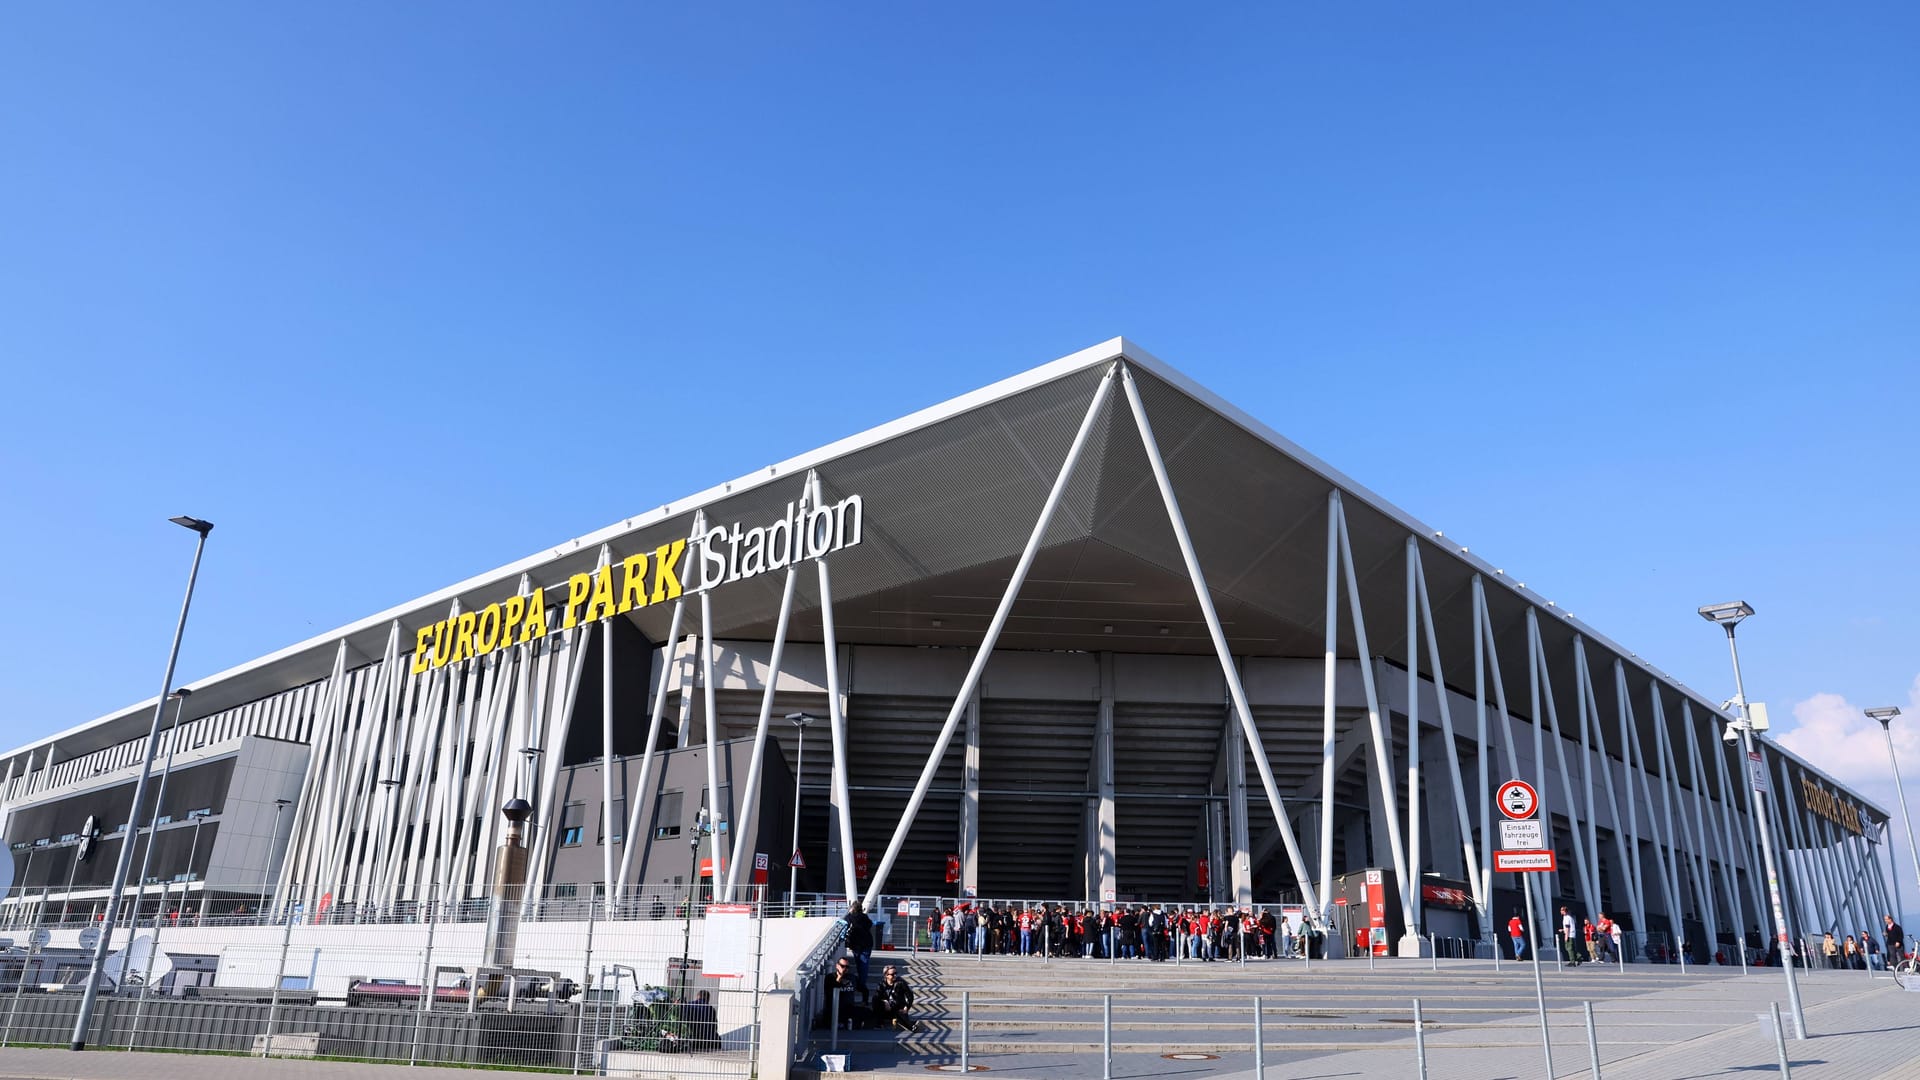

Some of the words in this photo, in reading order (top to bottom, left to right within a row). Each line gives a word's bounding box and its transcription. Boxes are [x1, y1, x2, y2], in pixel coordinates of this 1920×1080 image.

[412, 587, 548, 675] EUROPA
[564, 538, 687, 629] PARK
[701, 494, 863, 590] Stadion
[1801, 779, 1841, 825] EUROPA
[1838, 799, 1862, 835] PARK
[1504, 832, 1539, 840] fahrzeuge
[757, 858, 767, 868] E2
[1368, 874, 1380, 882] E2
